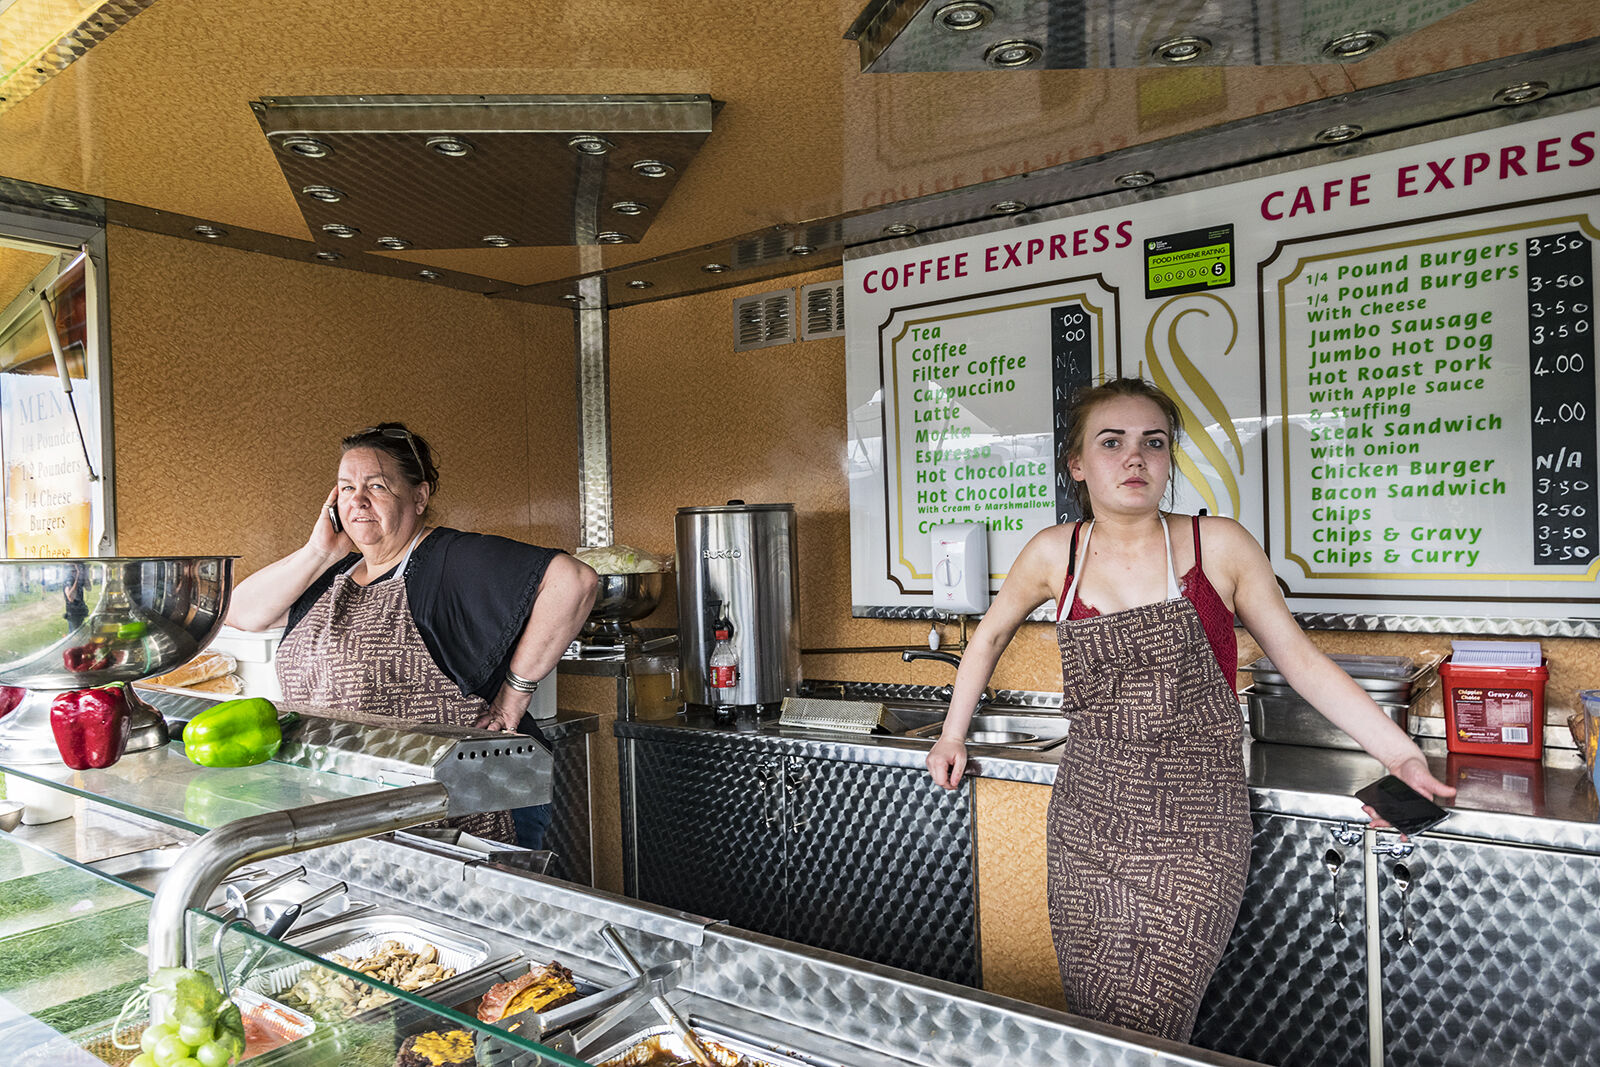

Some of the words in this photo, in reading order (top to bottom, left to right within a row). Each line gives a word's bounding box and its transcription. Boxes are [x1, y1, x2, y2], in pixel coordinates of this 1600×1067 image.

[1260, 173, 1371, 221] CAFE
[862, 252, 969, 294] COFFEE
[984, 219, 1134, 273] EXPRESS
[1152, 256, 1172, 265] FOOD
[1173, 252, 1200, 261] HYGIENE
[1201, 247, 1226, 257] RATING
[1306, 273, 1329, 286] 1/4
[1337, 255, 1409, 280] Pound
[1420, 241, 1519, 268] Burgers
[1215, 264, 1223, 275] 5
[1307, 293, 1329, 307] 1/4
[1339, 277, 1409, 301] Pound
[1421, 264, 1520, 290] Burgers
[1307, 306, 1351, 324] With
[1360, 298, 1427, 316] Cheese
[911, 326, 941, 342] Tea
[1309, 323, 1381, 348] Jumbo
[1391, 311, 1493, 335] Sausage
[912, 343, 967, 363] Coffee
[1309, 345, 1381, 369] Jumbo
[1392, 337, 1434, 357] Hot
[1446, 333, 1493, 352] Dog
[912, 365, 960, 383] Filter
[967, 355, 1027, 376] Coffee
[1056, 351, 1080, 378] N/A
[1309, 368, 1348, 386] Hot
[1357, 361, 1424, 382] Roast
[1434, 354, 1493, 373] Pork
[1534, 353, 1585, 377] 4.00
[913, 379, 1016, 405] Cappuccino
[1362, 382, 1416, 401] Apple
[1425, 378, 1485, 394] Sauce
[914, 406, 960, 423] Latte
[1309, 408, 1322, 420] &
[1330, 402, 1411, 420] Stuffing
[1534, 401, 1586, 425] 4.00
[1310, 423, 1374, 442] Steak
[1384, 413, 1502, 437] Sandwich
[916, 445, 991, 466] Espresso
[1363, 441, 1420, 456] Onion
[1535, 446, 1582, 472] N/A
[38, 457, 81, 478] Pounders
[916, 468, 947, 484] Hot
[954, 462, 1047, 481] Chocolate
[1311, 462, 1399, 480] Chicken
[1410, 457, 1496, 477] Burger
[40, 489, 72, 507] Cheese
[917, 488, 948, 504] Hot
[955, 483, 1048, 502] Chocolate
[1311, 485, 1377, 501] Bacon
[1387, 478, 1506, 499] Sandwich
[918, 506, 939, 514] With
[942, 505, 971, 513] Cream
[974, 503, 982, 511] &
[984, 500, 1055, 511] Marshmallows
[1312, 506, 1372, 525] Chips
[30, 515, 66, 536] Burgers
[1312, 527, 1372, 546] Chips
[1384, 528, 1400, 540] &
[1410, 526, 1483, 545] Gravy
[1313, 548, 1373, 567] Chips
[1384, 550, 1400, 563] &
[1411, 548, 1480, 567] Curry
[1488, 691, 1511, 699] Gravy
